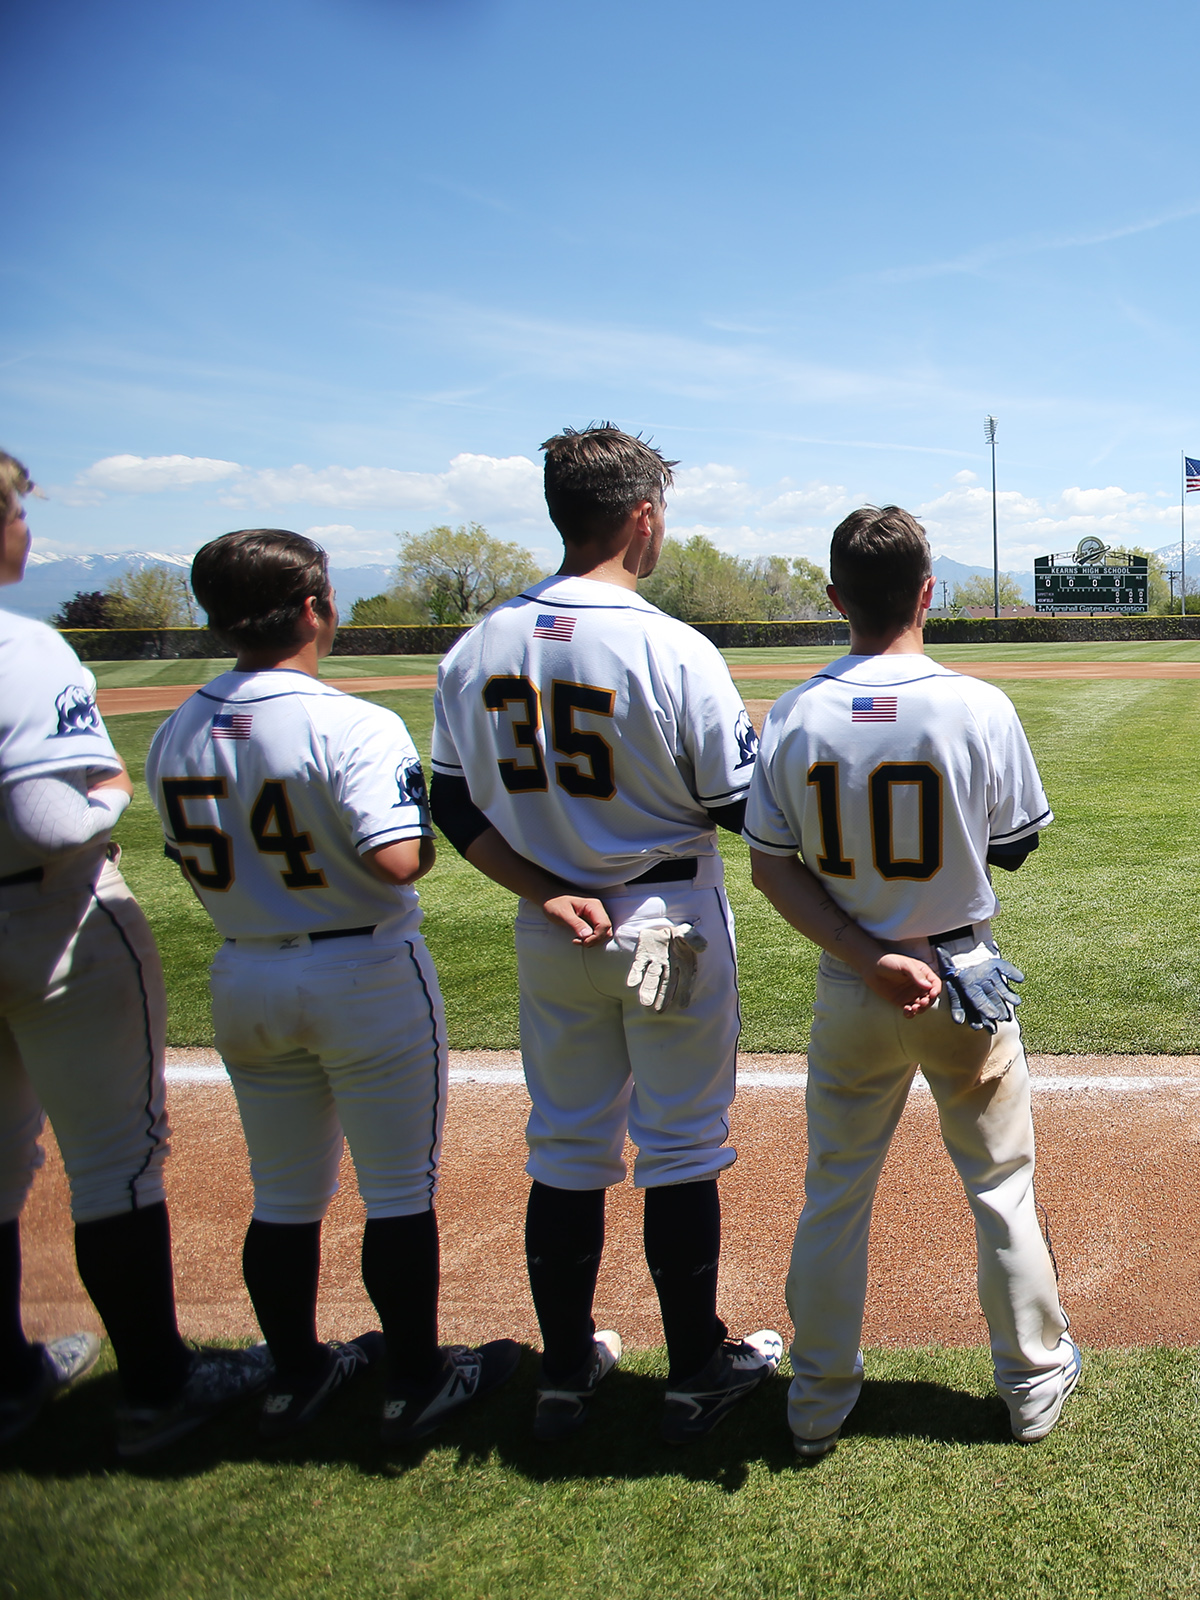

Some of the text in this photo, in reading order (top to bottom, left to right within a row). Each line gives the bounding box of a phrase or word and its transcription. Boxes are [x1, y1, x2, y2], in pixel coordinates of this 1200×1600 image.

[1046, 579, 1050, 587] 0
[1069, 579, 1074, 587] 0
[1092, 579, 1097, 587] 0
[1115, 579, 1120, 587] 0
[481, 674, 617, 802] 35
[806, 760, 943, 882] 10
[161, 776, 329, 892] 54
